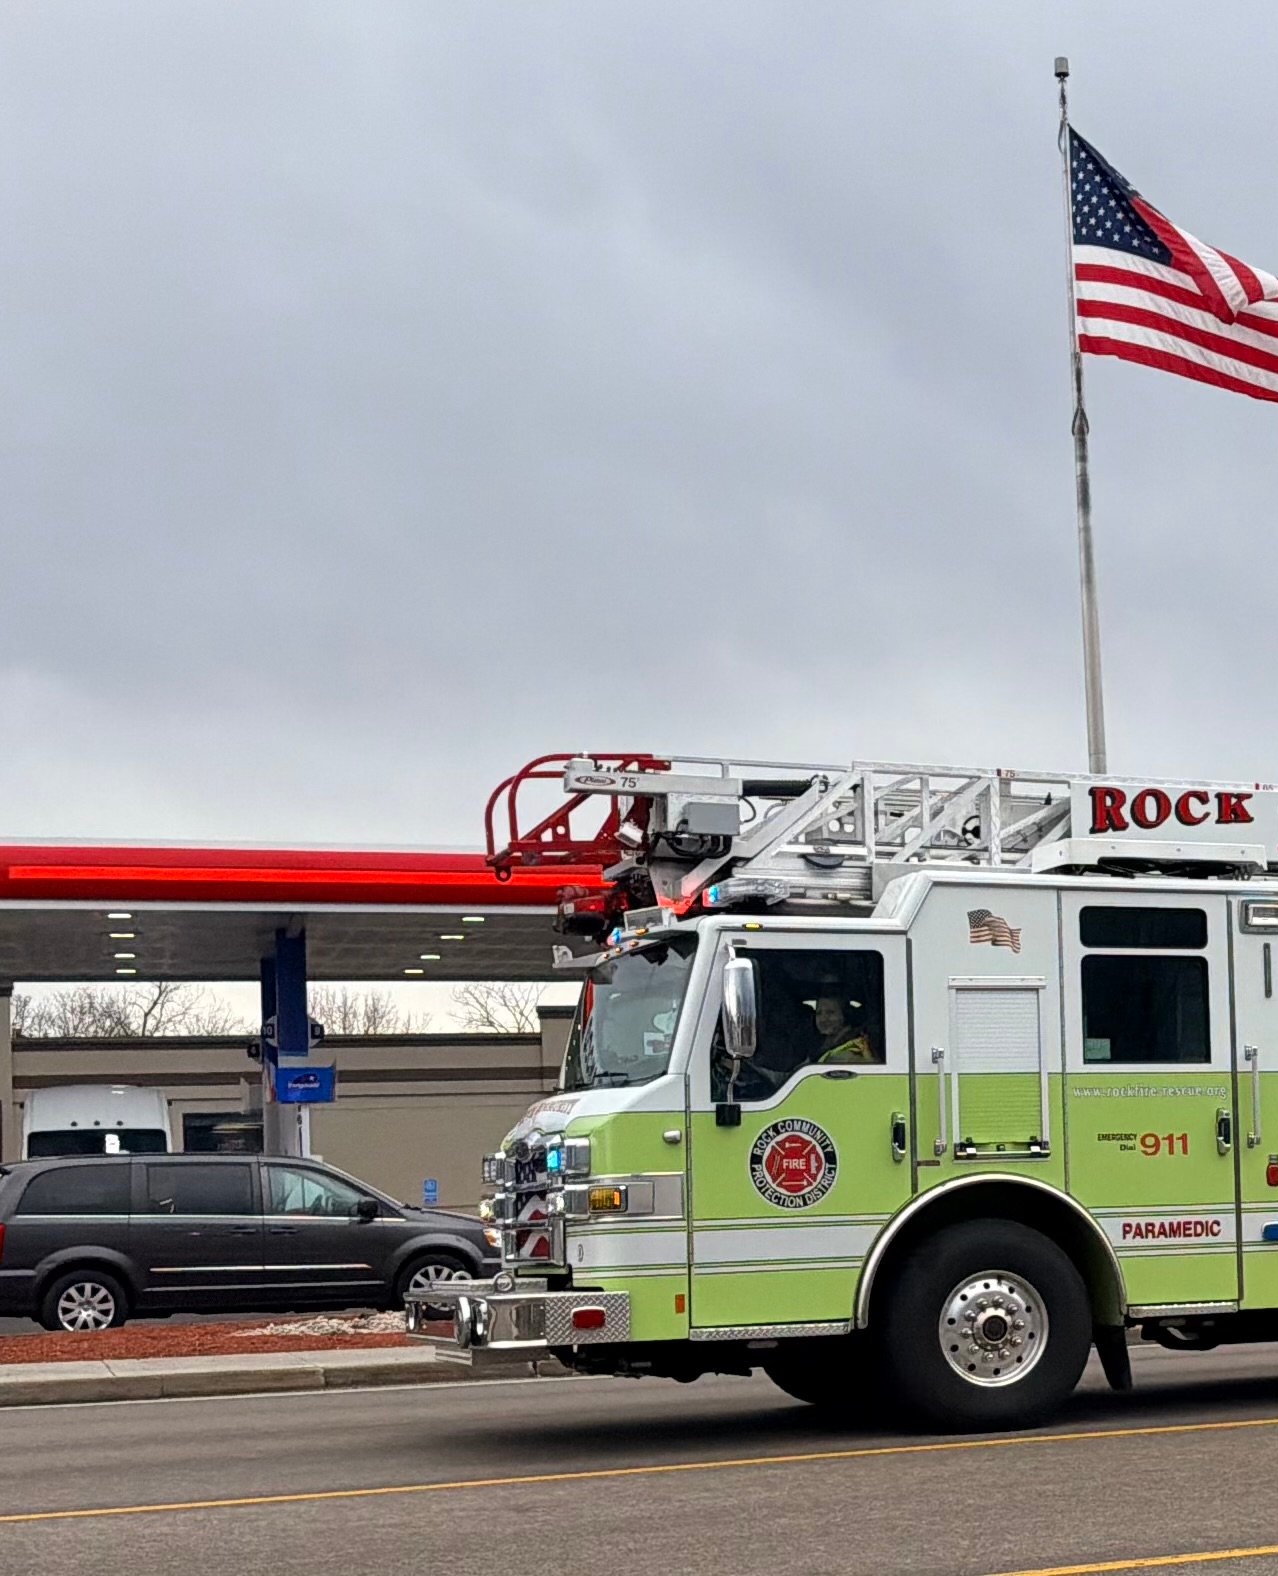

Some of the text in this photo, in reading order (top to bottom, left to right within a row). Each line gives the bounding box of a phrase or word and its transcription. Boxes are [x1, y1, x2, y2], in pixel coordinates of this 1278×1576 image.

[1088, 786, 1254, 834] ROCK
[753, 1120, 834, 1155] ROCK COMMUNITY
[1097, 1133, 1137, 1141] EMERGENCY
[1140, 1132, 1189, 1156] 911
[782, 1158, 807, 1170] FIRE
[751, 1163, 836, 1207] PROTECTION DISTRICT
[1122, 1220, 1222, 1240] PARAMEDIC
